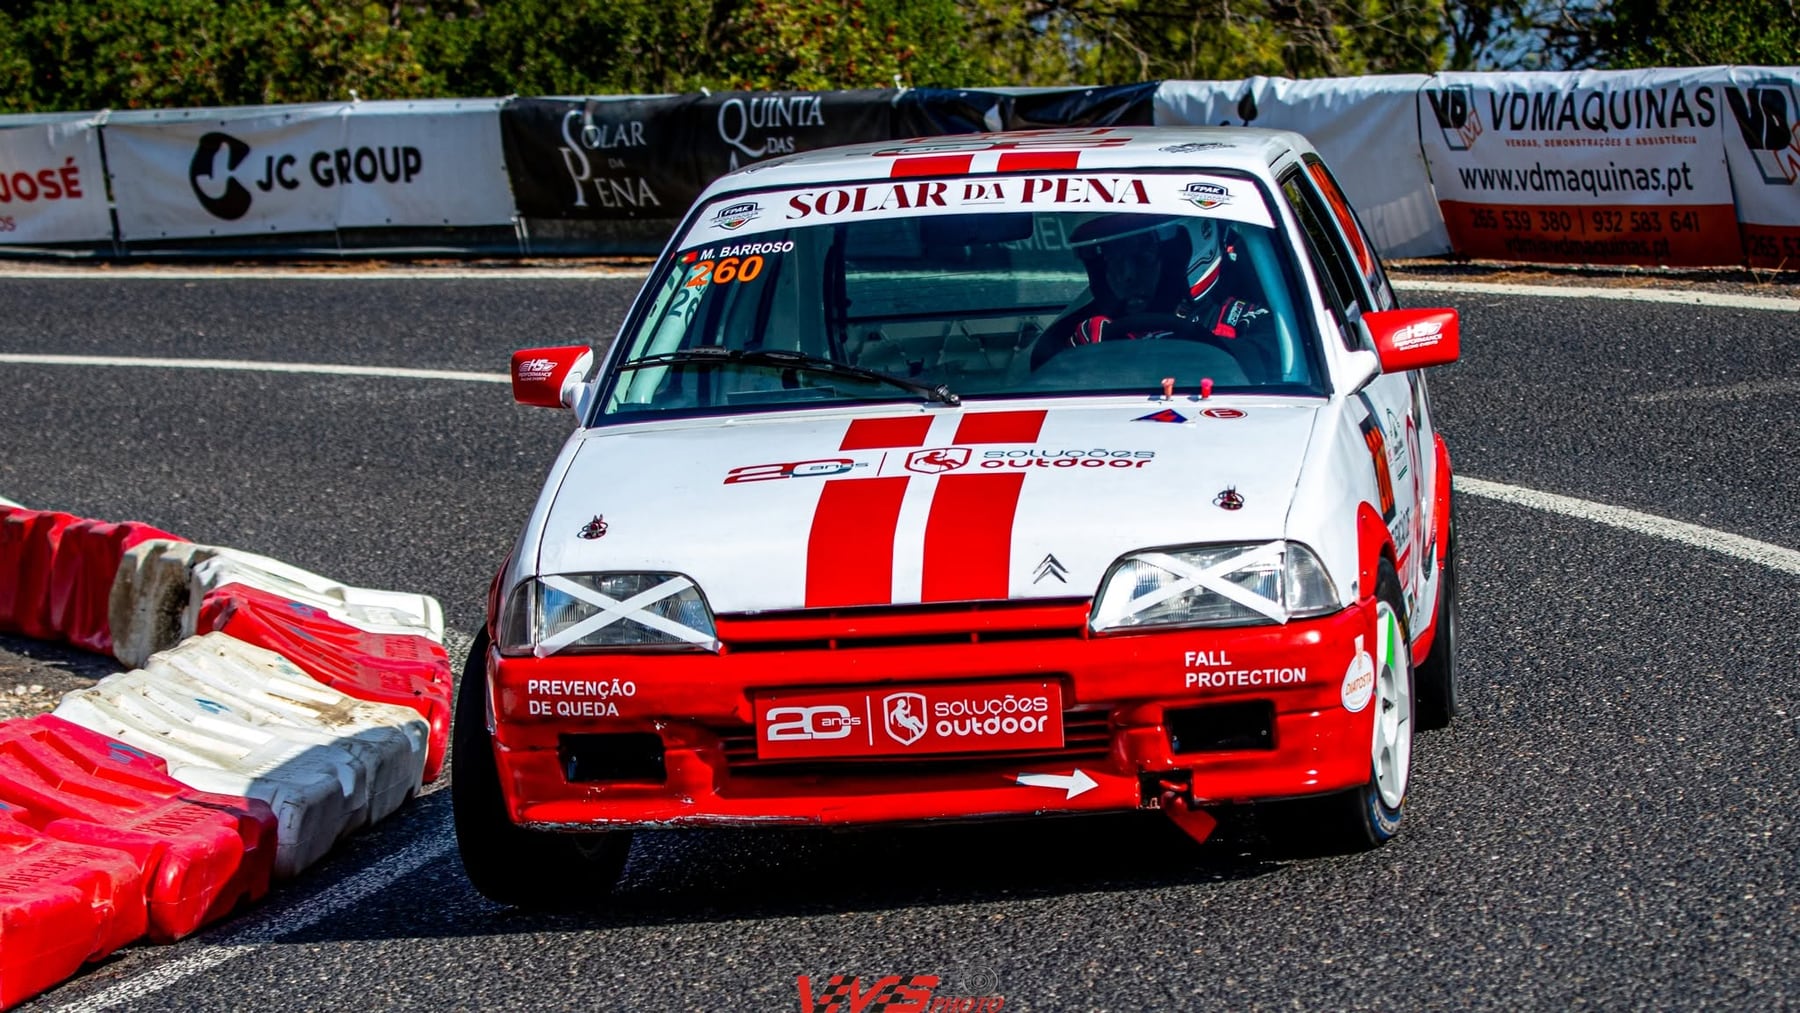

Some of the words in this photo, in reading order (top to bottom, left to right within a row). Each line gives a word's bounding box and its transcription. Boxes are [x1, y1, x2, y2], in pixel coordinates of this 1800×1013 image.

[718, 96, 825, 158] QUINTA
[561, 109, 648, 180] SOLAR
[767, 136, 795, 154] DAS
[1625, 137, 1631, 146] E
[256, 154, 300, 193] JC
[310, 145, 422, 187] GROUP
[608, 157, 625, 169] DA
[557, 147, 661, 207] PENA
[1459, 161, 1694, 197] www.vdmaquinas.pt
[785, 183, 949, 220] SOLAR
[963, 184, 1004, 201] DA
[1021, 178, 1151, 206] PENA
[1471, 209, 1497, 230] 265
[1503, 210, 1531, 231] 539
[1540, 211, 1571, 232] 380
[1592, 211, 1623, 232] 932
[1631, 211, 1662, 232] 583
[1669, 211, 1700, 232] 641
[700, 248, 716, 260] M.
[719, 241, 794, 258] BARROSO
[686, 255, 764, 287] 260
[981, 457, 1155, 469] outdoor
[984, 447, 1155, 459] soluções
[723, 457, 855, 485] 20
[1185, 650, 1231, 667] FALL
[528, 678, 636, 699] PREVENÇÃO
[1185, 667, 1307, 688] PROTECTION
[529, 700, 552, 716] DE
[557, 700, 620, 717] QUEDA
[934, 694, 1048, 717] soluções
[766, 705, 851, 741] 20
[821, 716, 861, 727] anos
[936, 715, 1048, 738] outdoor
